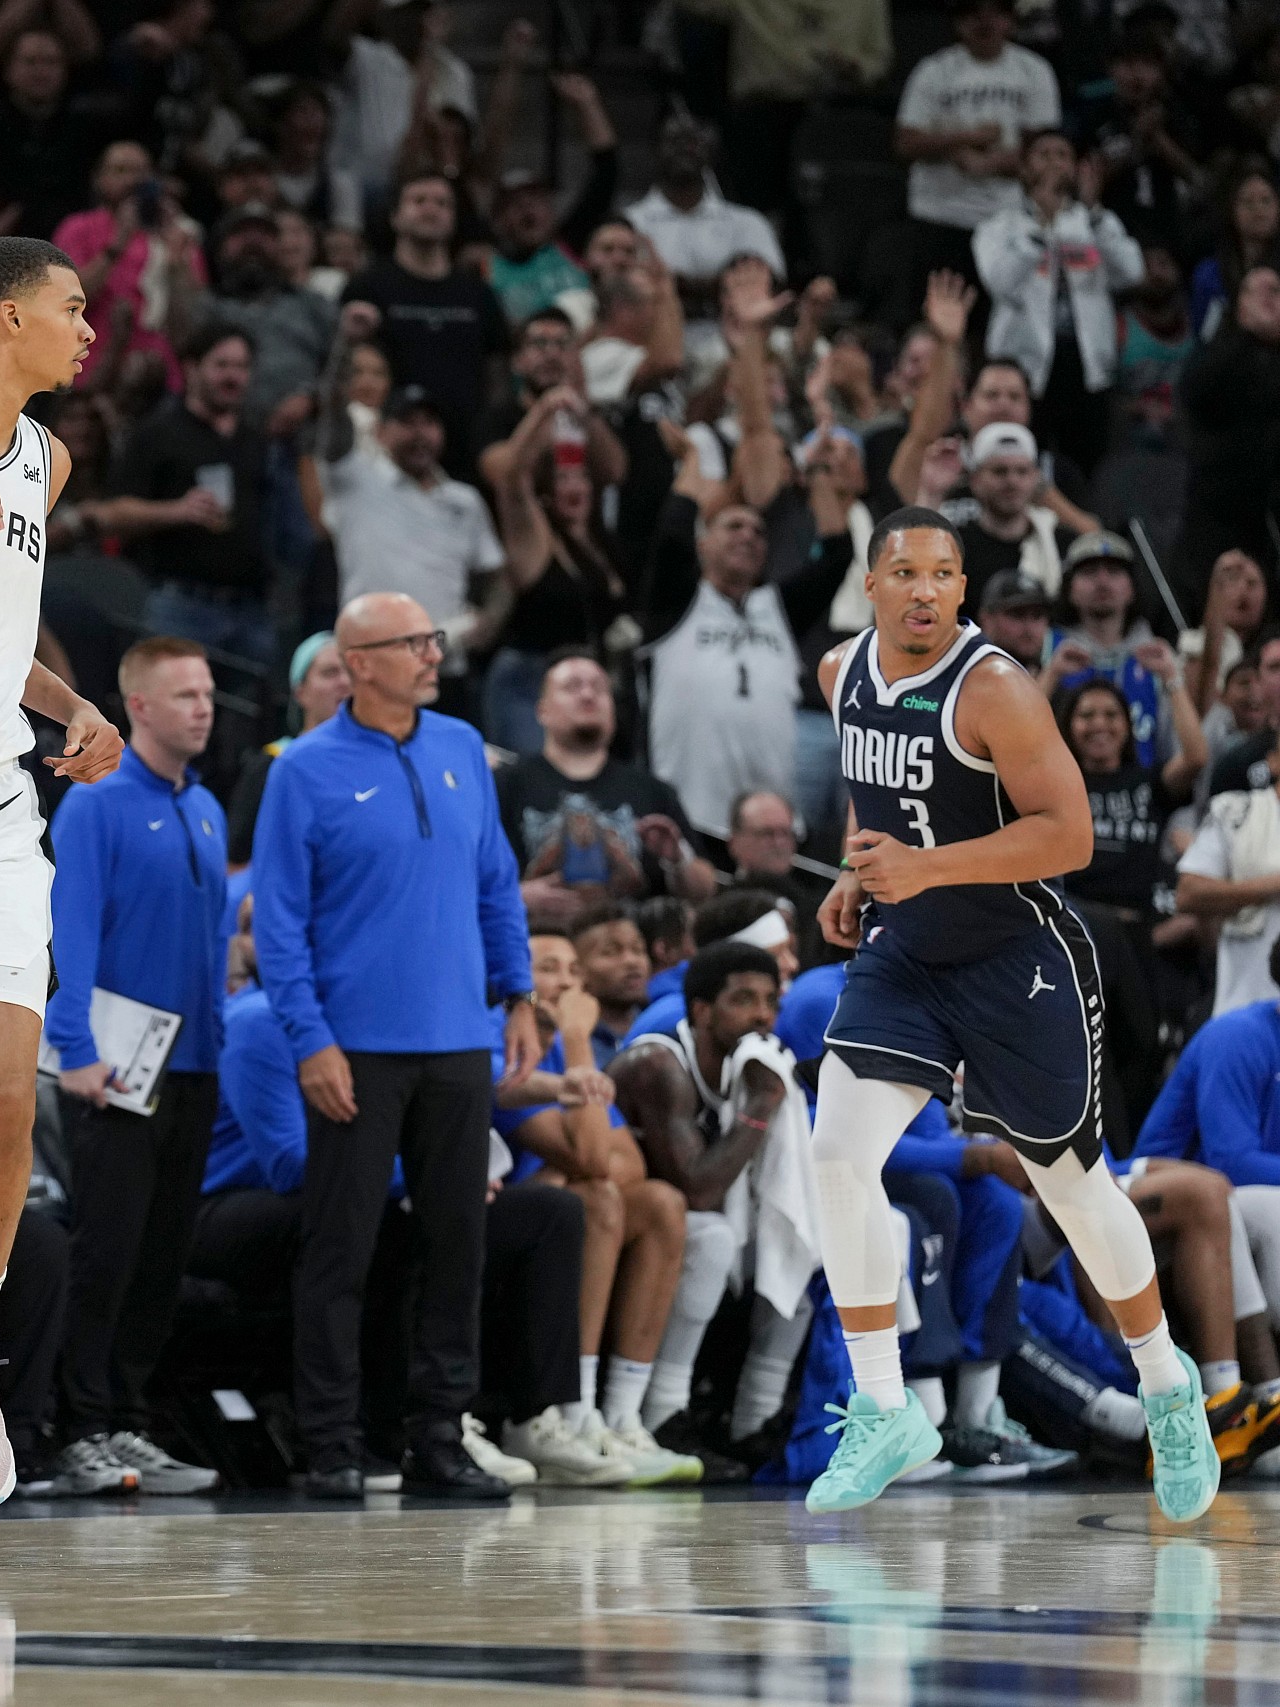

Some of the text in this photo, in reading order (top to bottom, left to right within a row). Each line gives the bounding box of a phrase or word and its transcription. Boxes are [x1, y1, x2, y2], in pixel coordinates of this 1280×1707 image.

[23, 464, 42, 484] Self.
[736, 663, 750, 698] 1
[902, 694, 939, 713] chime
[899, 797, 936, 849] 3
